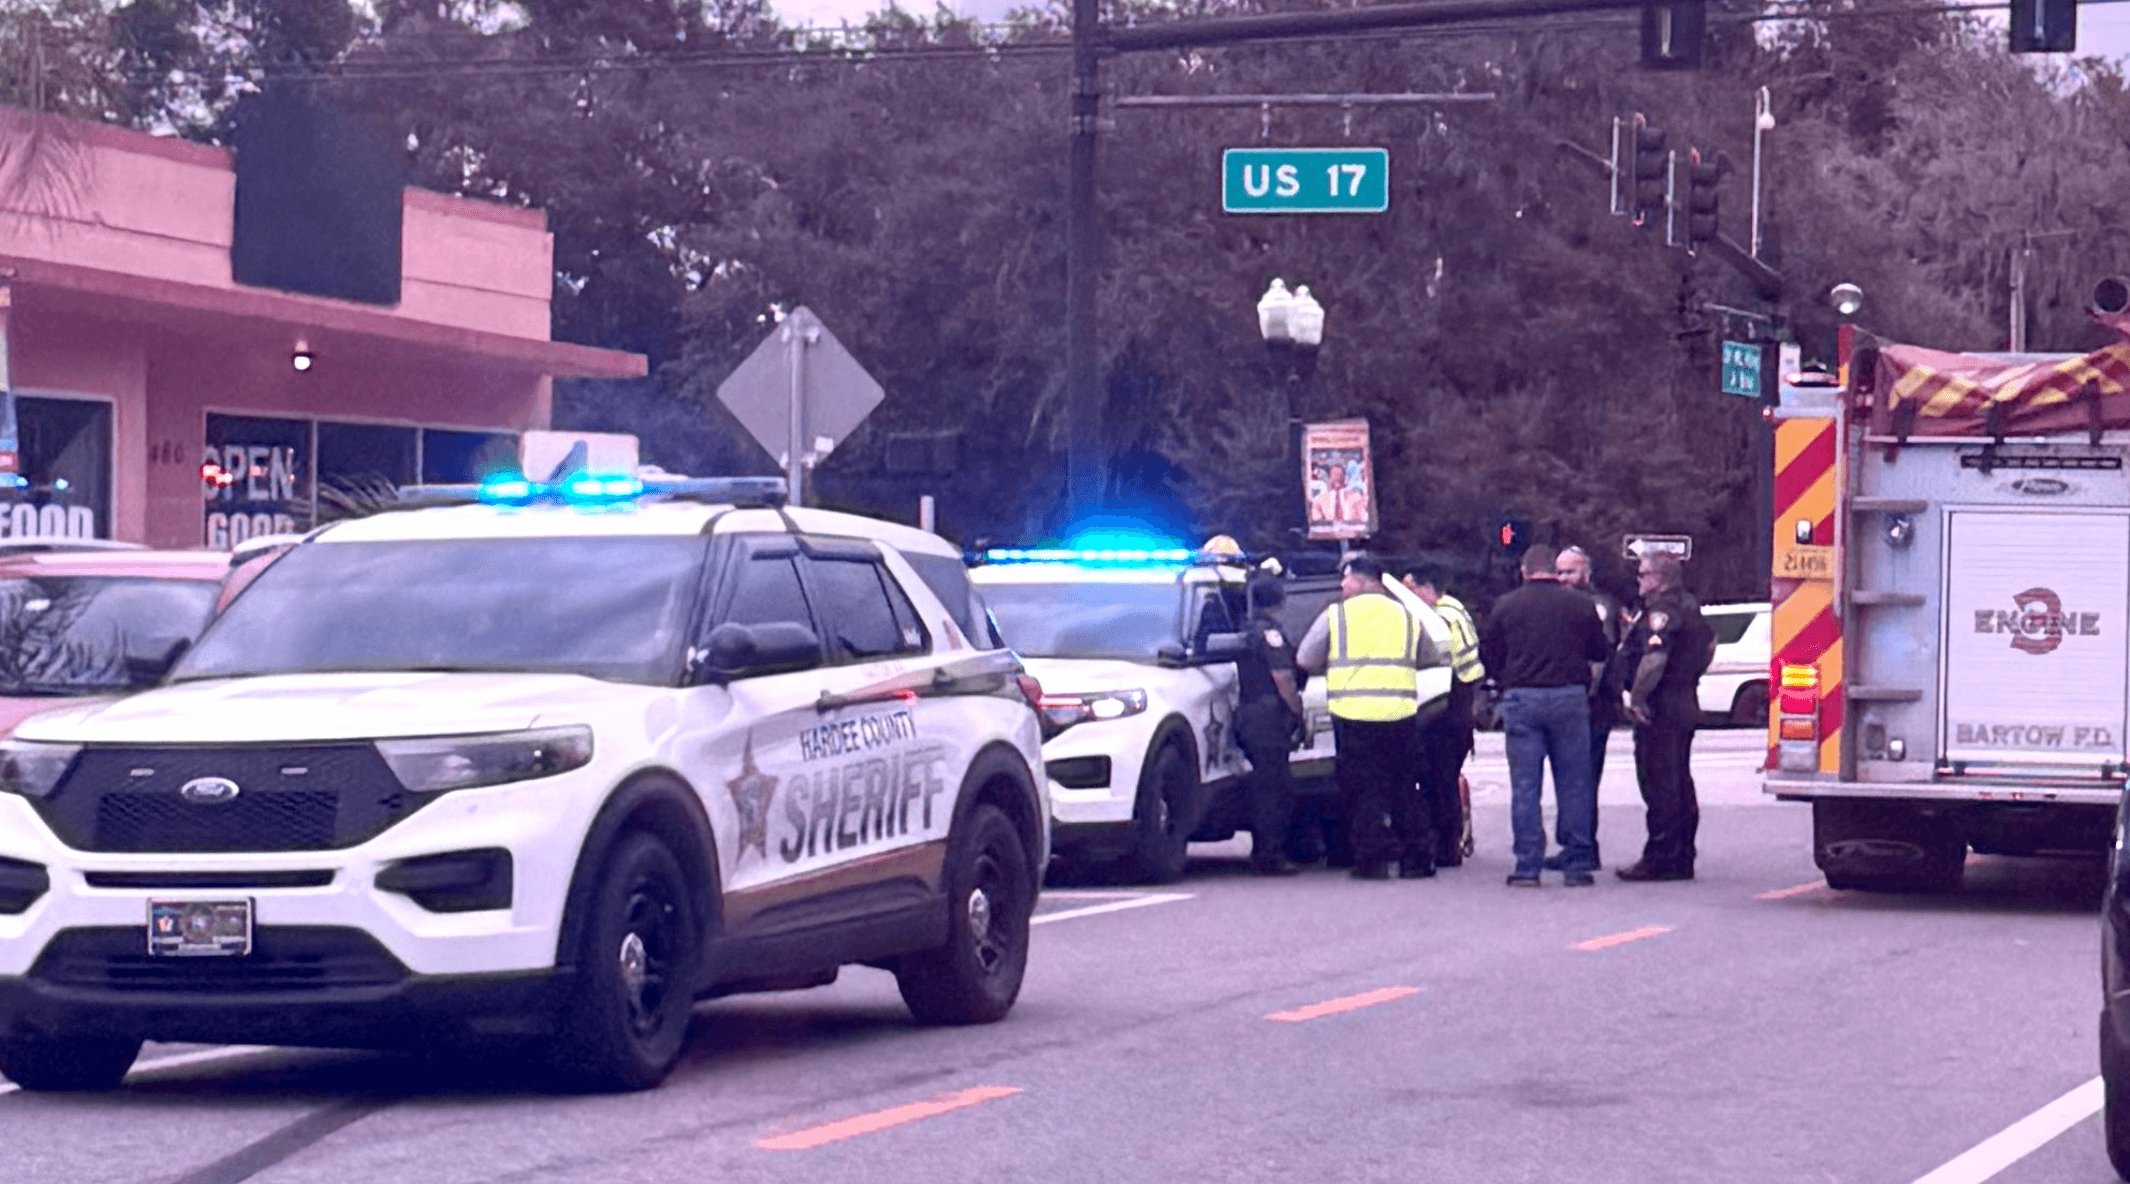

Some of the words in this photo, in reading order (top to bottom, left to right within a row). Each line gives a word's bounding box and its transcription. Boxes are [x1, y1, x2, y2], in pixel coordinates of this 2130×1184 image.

[1243, 163, 1300, 198] US
[1326, 163, 1367, 197] 17
[203, 444, 294, 501] OPEN
[1974, 609, 2101, 636] ENGINE
[2010, 587, 2063, 656] 3
[801, 720, 861, 763] HARDEE
[860, 711, 917, 750] COUNTY
[1956, 722, 2066, 747] BARTOW
[780, 744, 946, 864] SHERIFF
